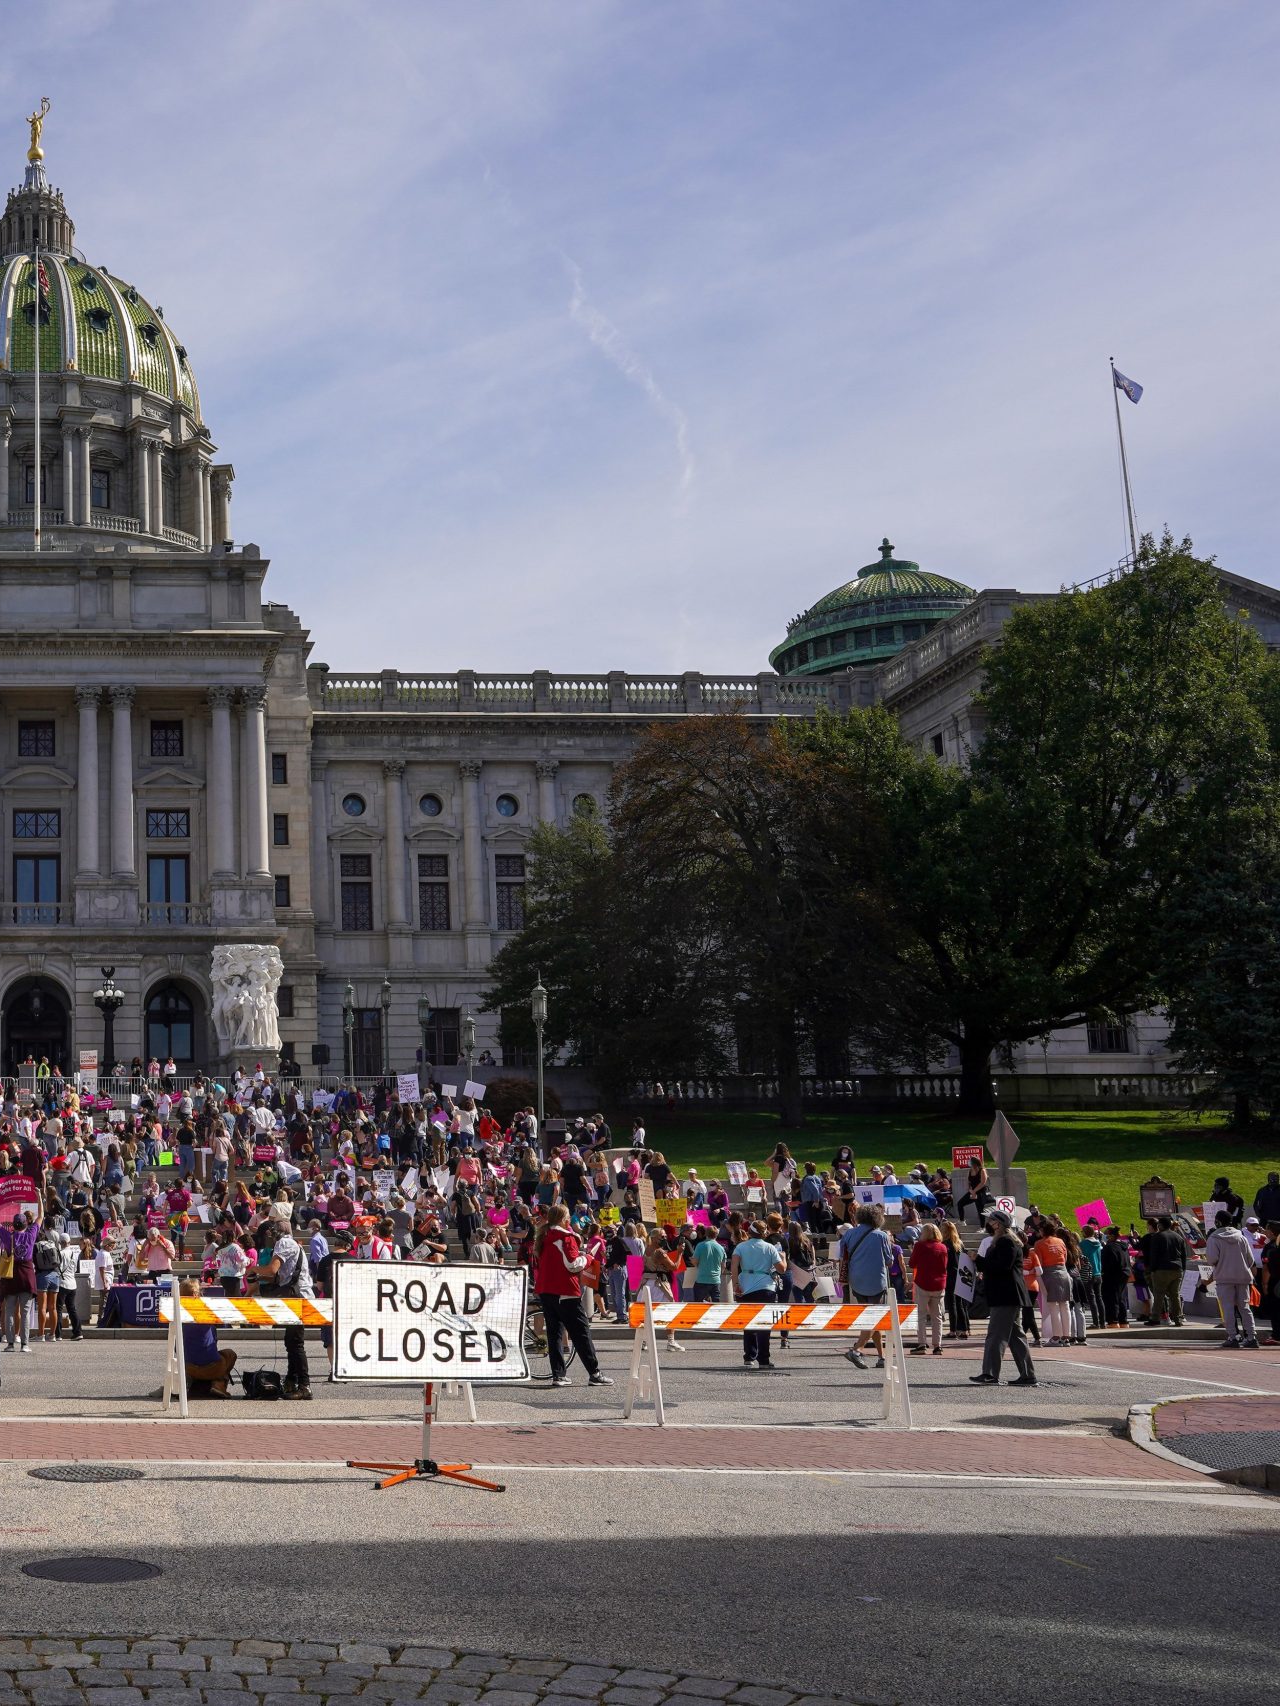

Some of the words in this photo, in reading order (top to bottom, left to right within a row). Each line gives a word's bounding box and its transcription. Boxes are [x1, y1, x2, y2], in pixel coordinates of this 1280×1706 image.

[377, 1279, 486, 1314] ROAD
[773, 1311, 791, 1324] HTE
[350, 1328, 508, 1362] CLOSED
